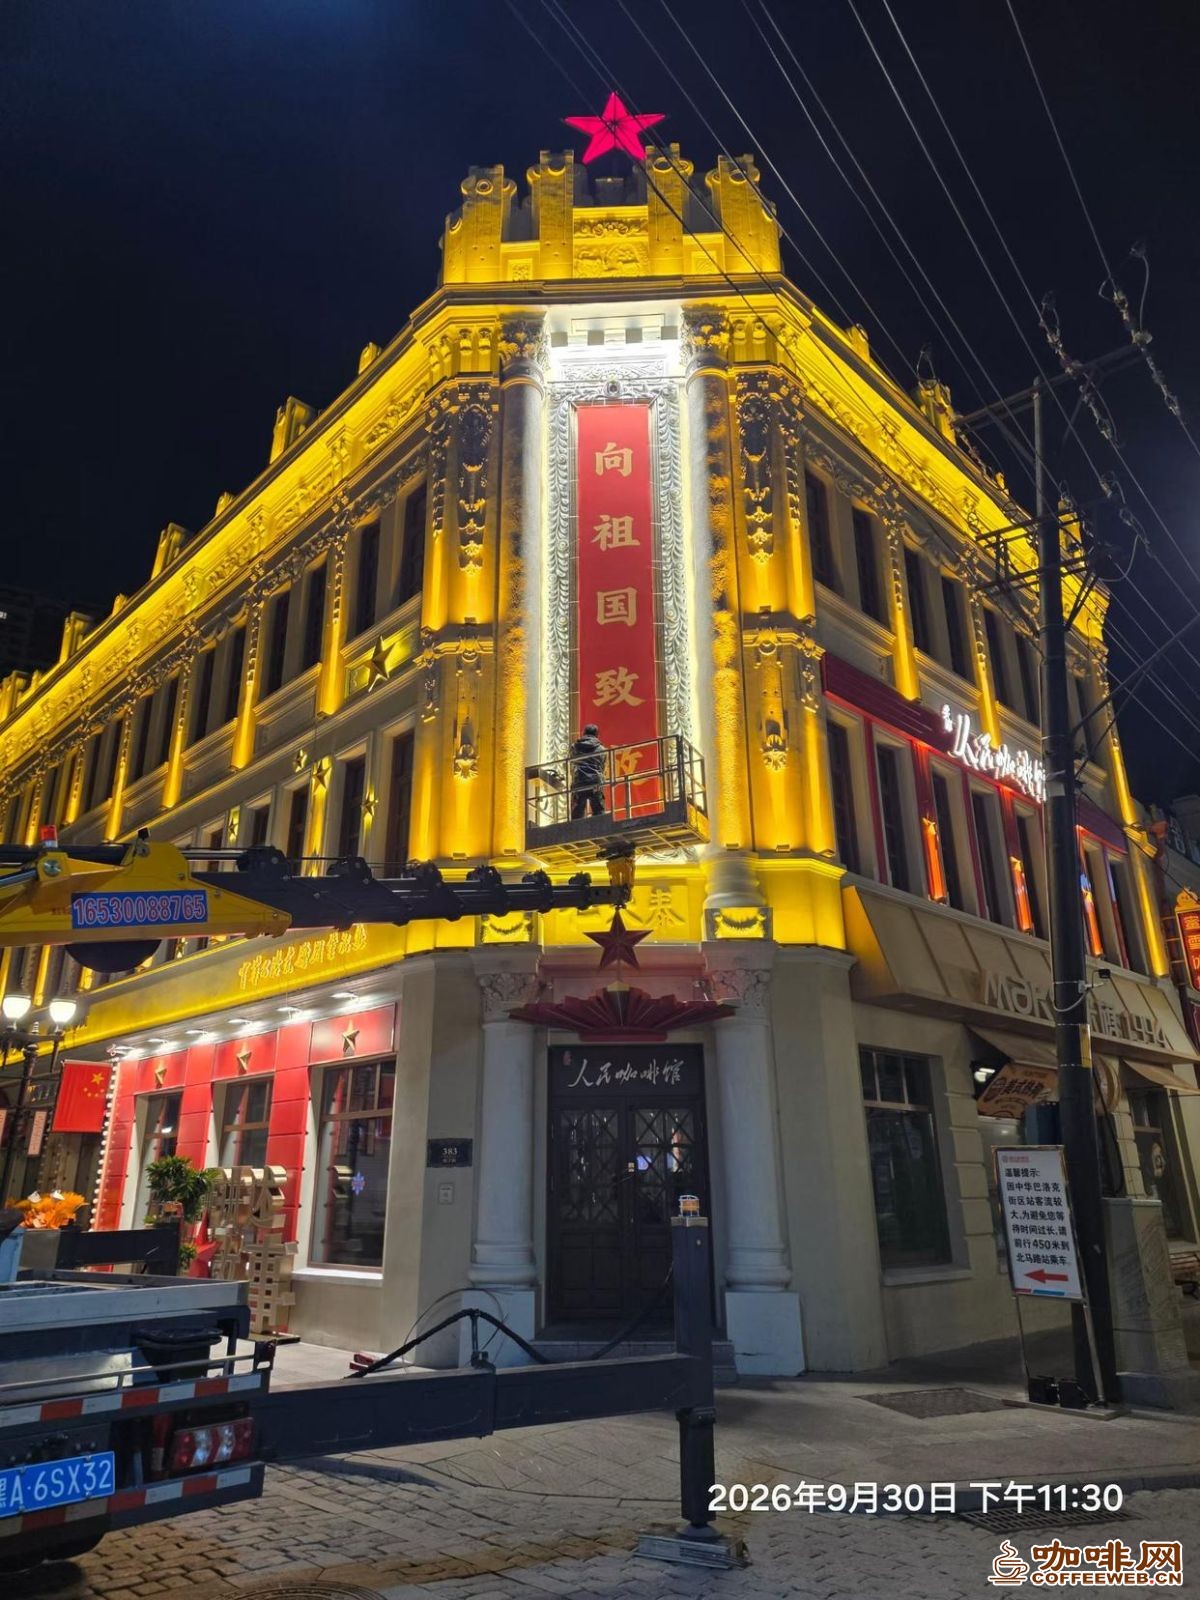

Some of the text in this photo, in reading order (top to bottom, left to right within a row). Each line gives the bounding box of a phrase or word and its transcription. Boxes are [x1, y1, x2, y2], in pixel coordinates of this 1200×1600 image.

[73, 894, 206, 925] 16530088765
[567, 1058, 684, 1088] 人民咖啡馆
[1006, 1181, 1061, 1192] 因中华巴洛克
[1008, 1195, 1063, 1207] 街区站客流较
